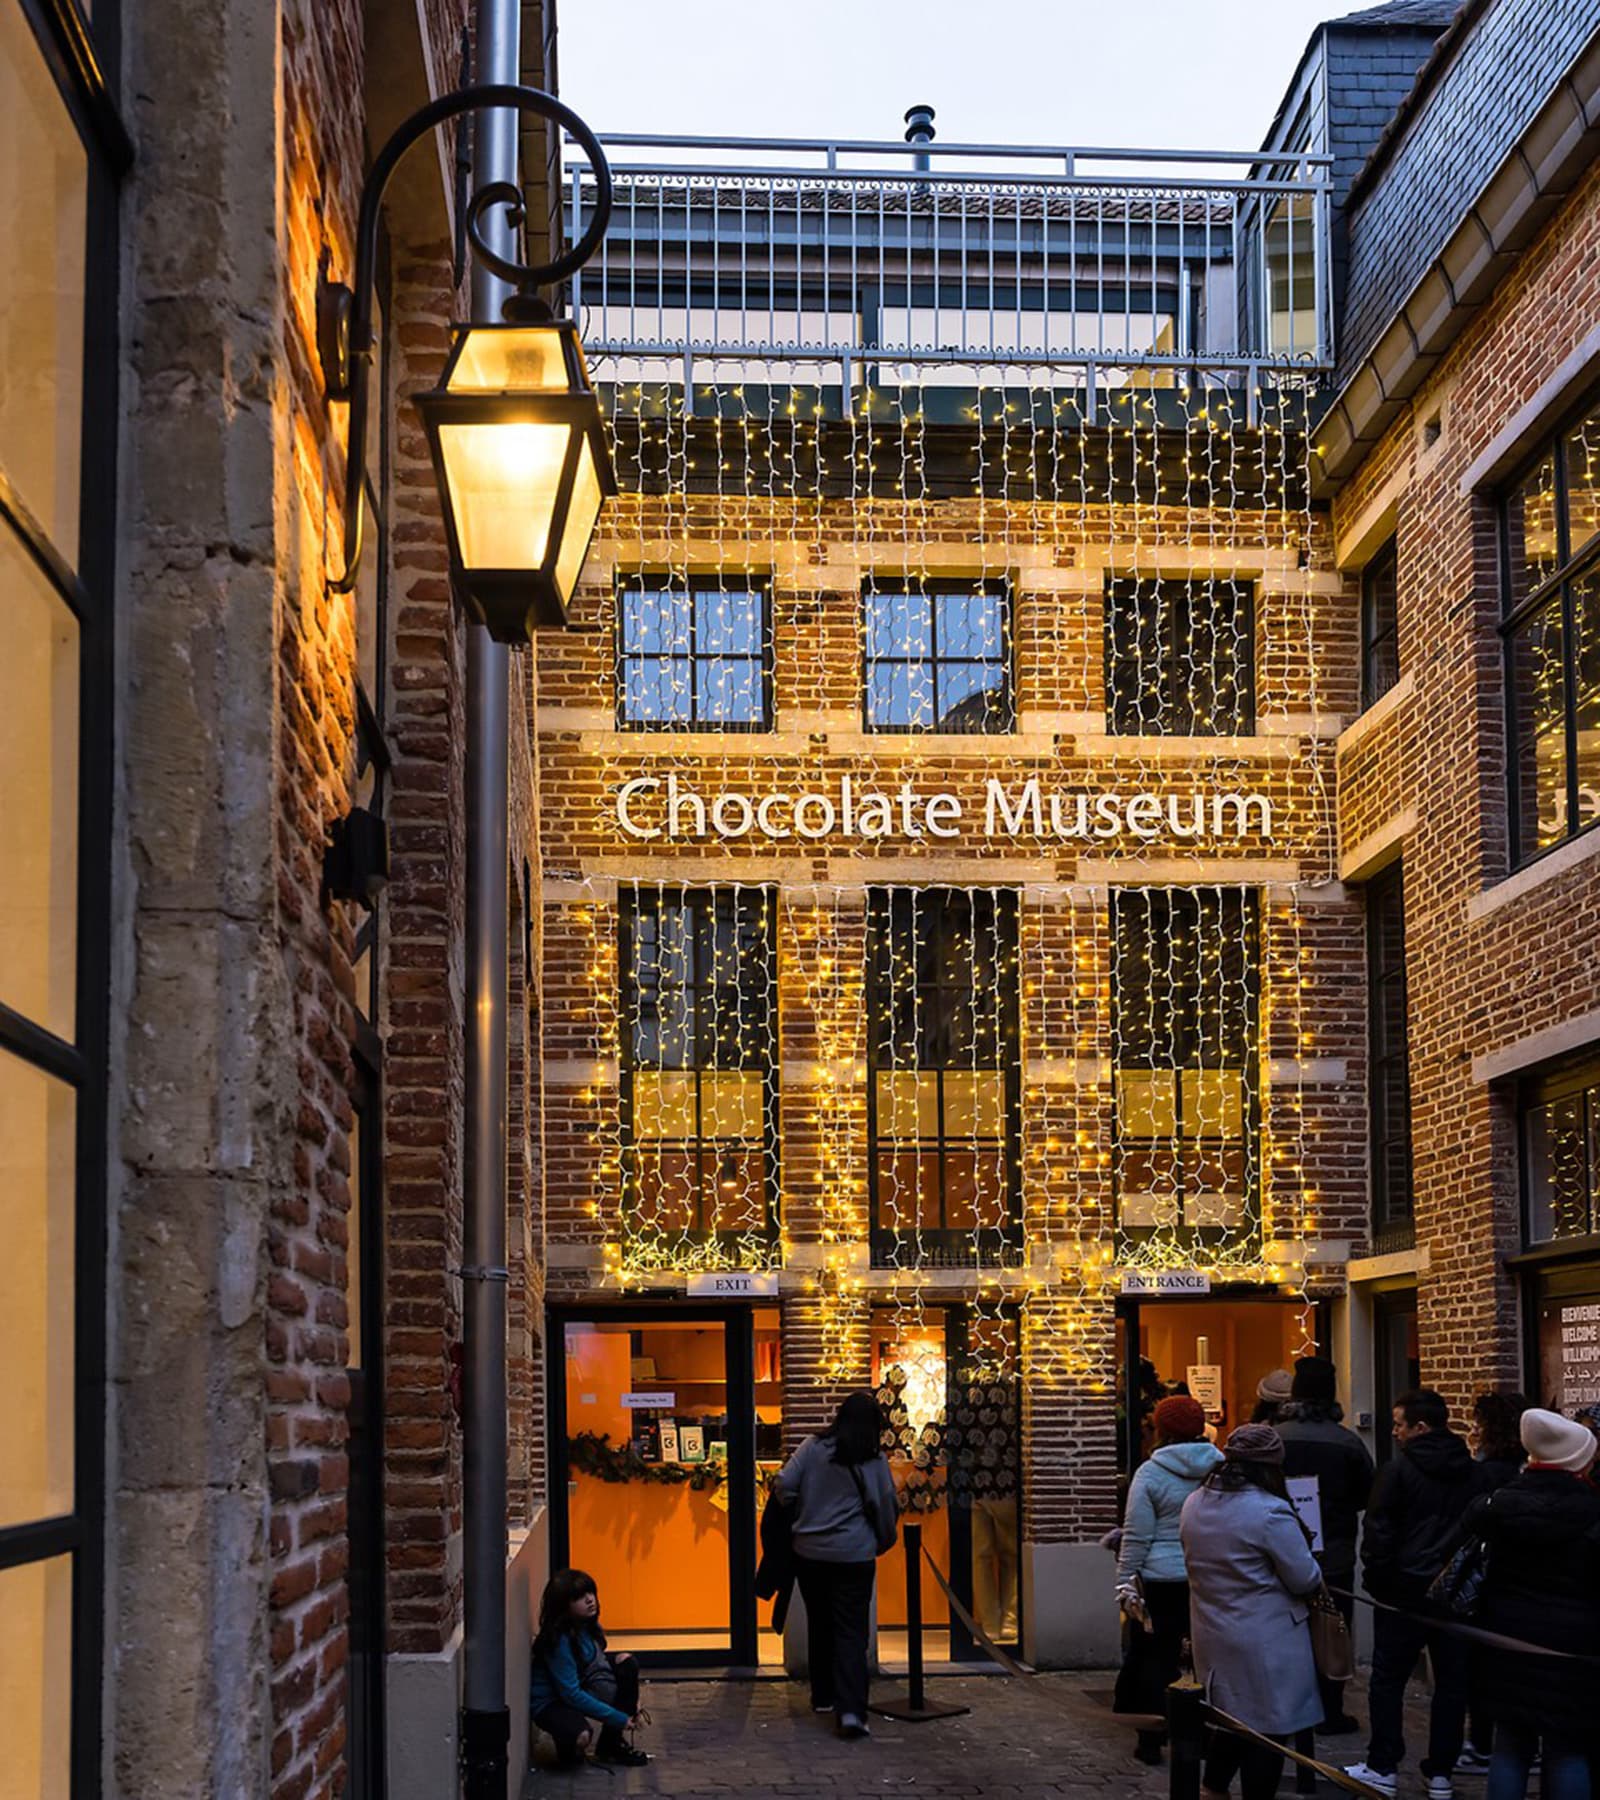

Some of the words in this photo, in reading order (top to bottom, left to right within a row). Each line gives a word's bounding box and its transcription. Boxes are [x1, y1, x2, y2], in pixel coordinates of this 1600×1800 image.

[616, 775, 962, 838] Chocolate
[985, 778, 1272, 838] Museum
[715, 1279, 752, 1291] EXIT
[1127, 1275, 1205, 1288] ENTRANCE
[1562, 1326, 1597, 1343] WELCOME
